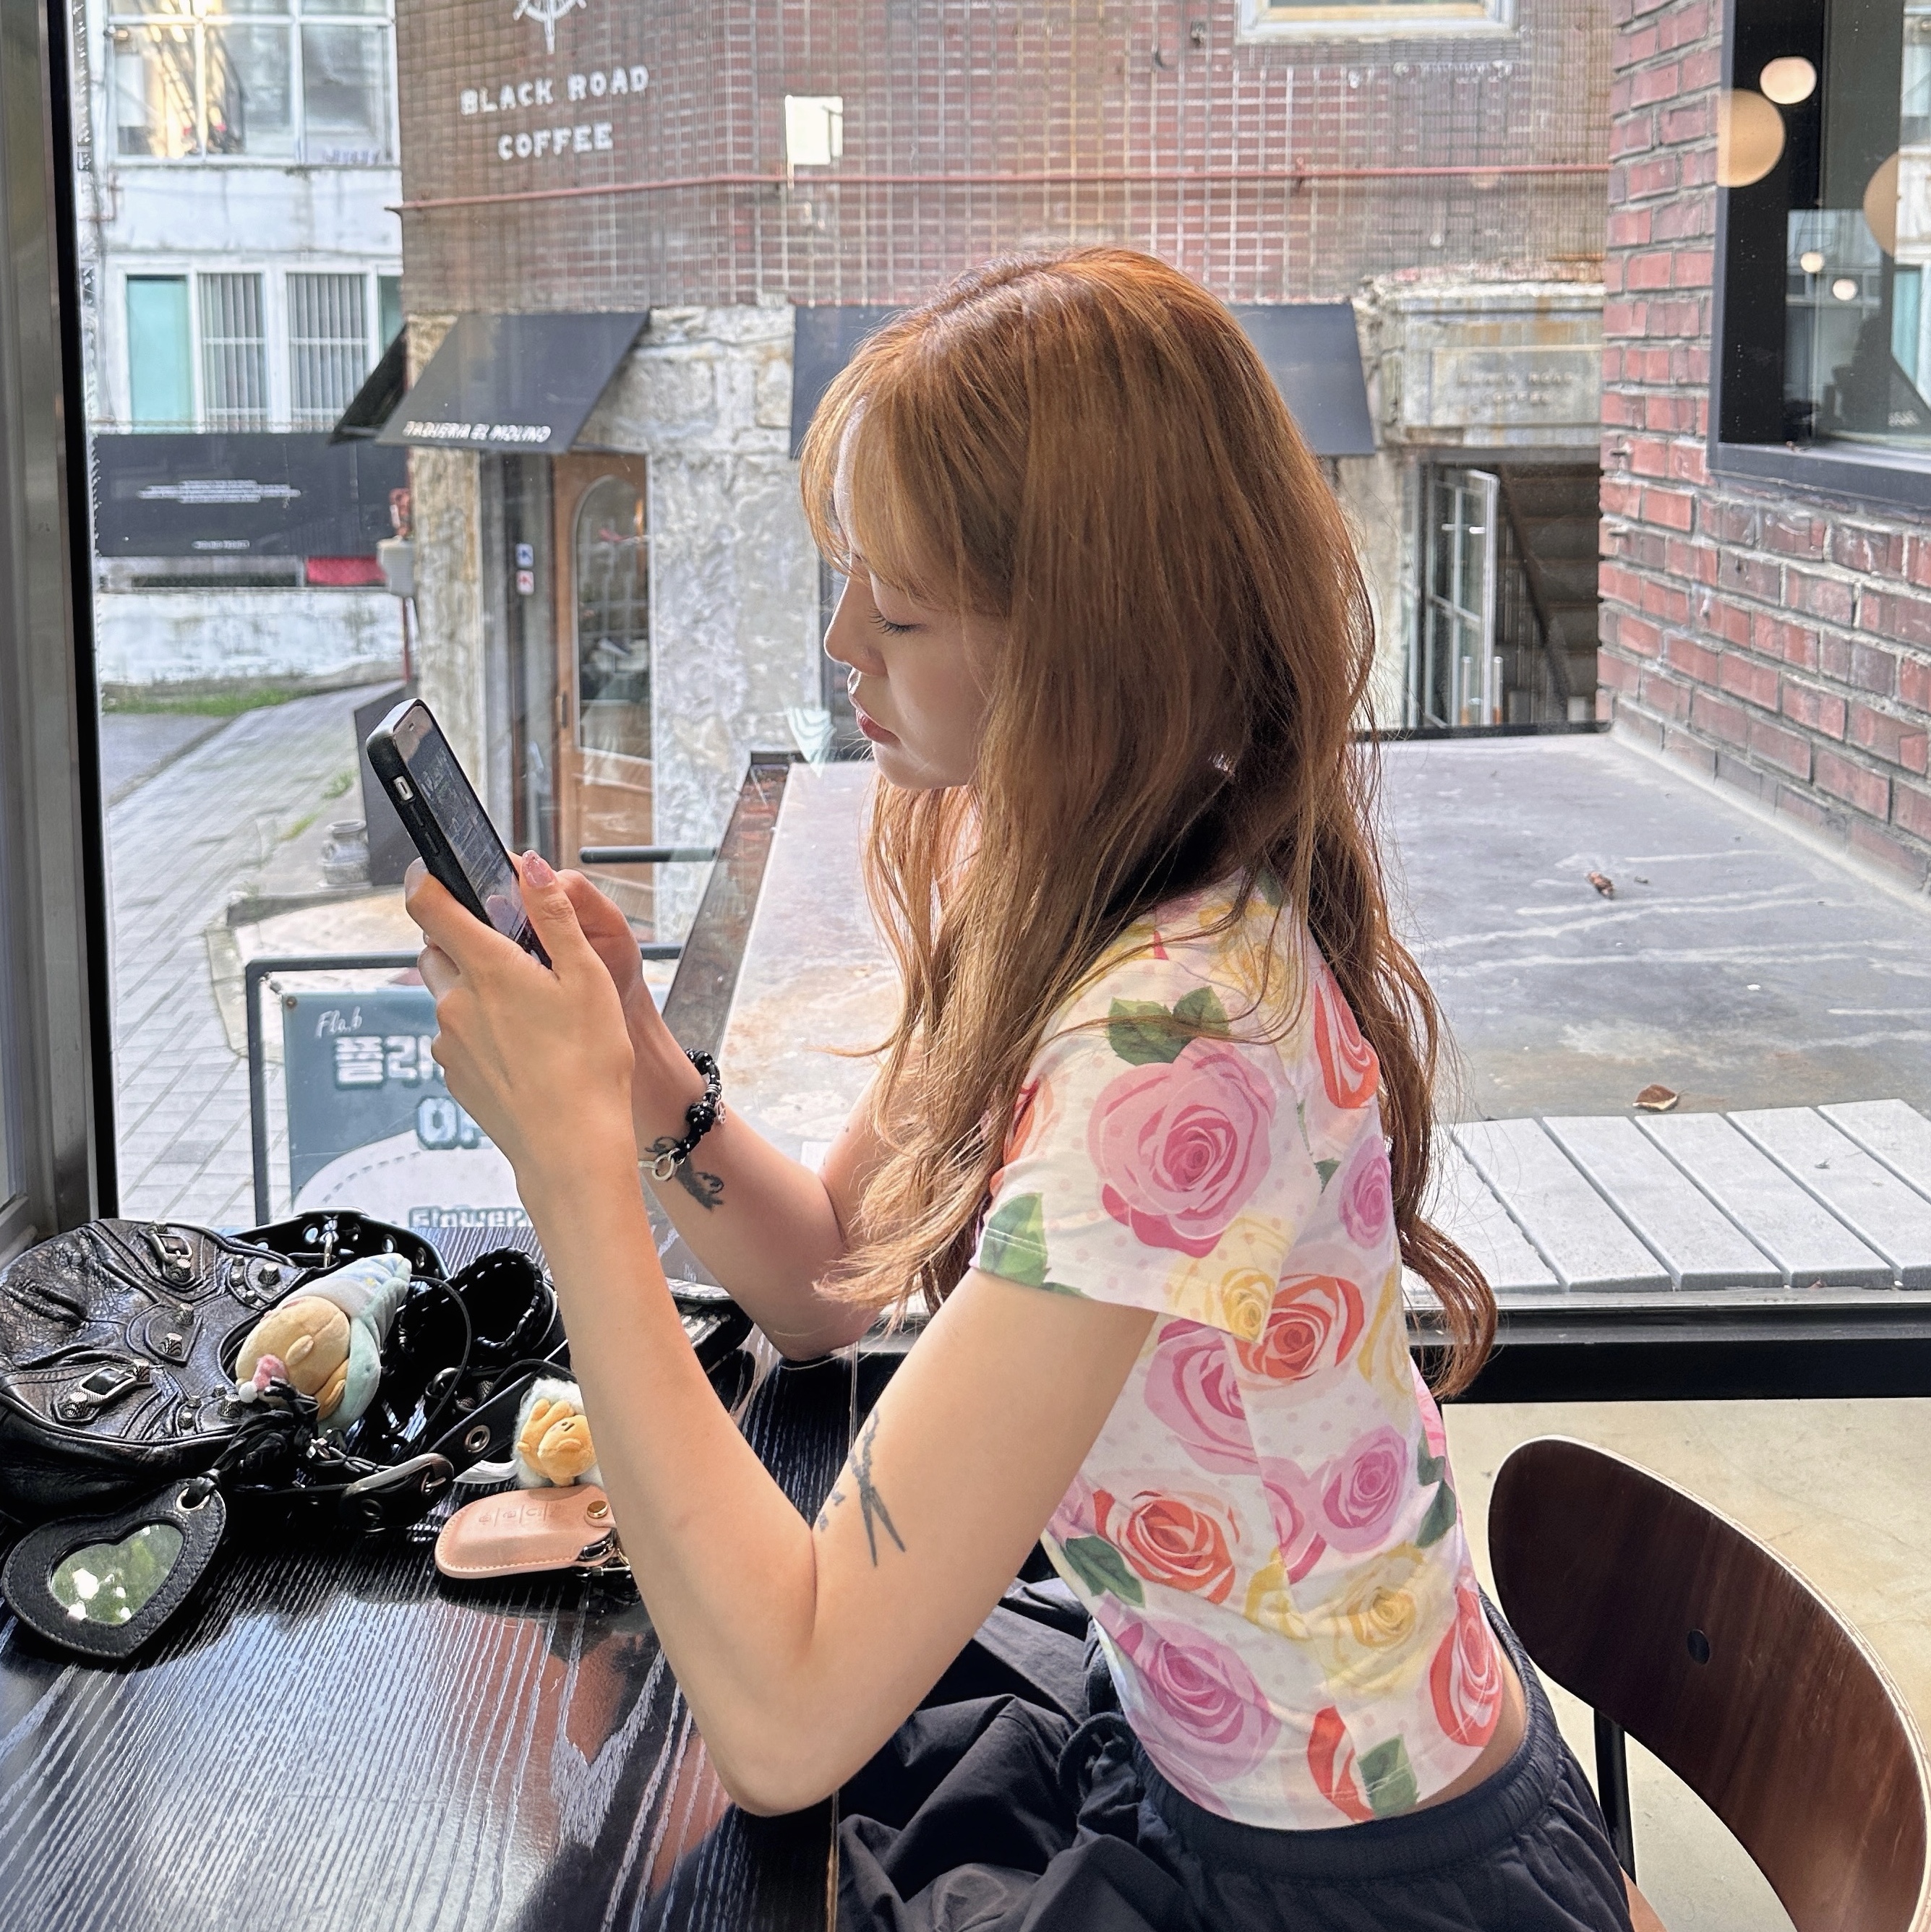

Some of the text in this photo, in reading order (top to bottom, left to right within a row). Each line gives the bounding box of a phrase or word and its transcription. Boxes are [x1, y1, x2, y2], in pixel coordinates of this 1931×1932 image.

[460, 64, 650, 116] BLACK ROAD
[497, 121, 614, 160] COFFEE
